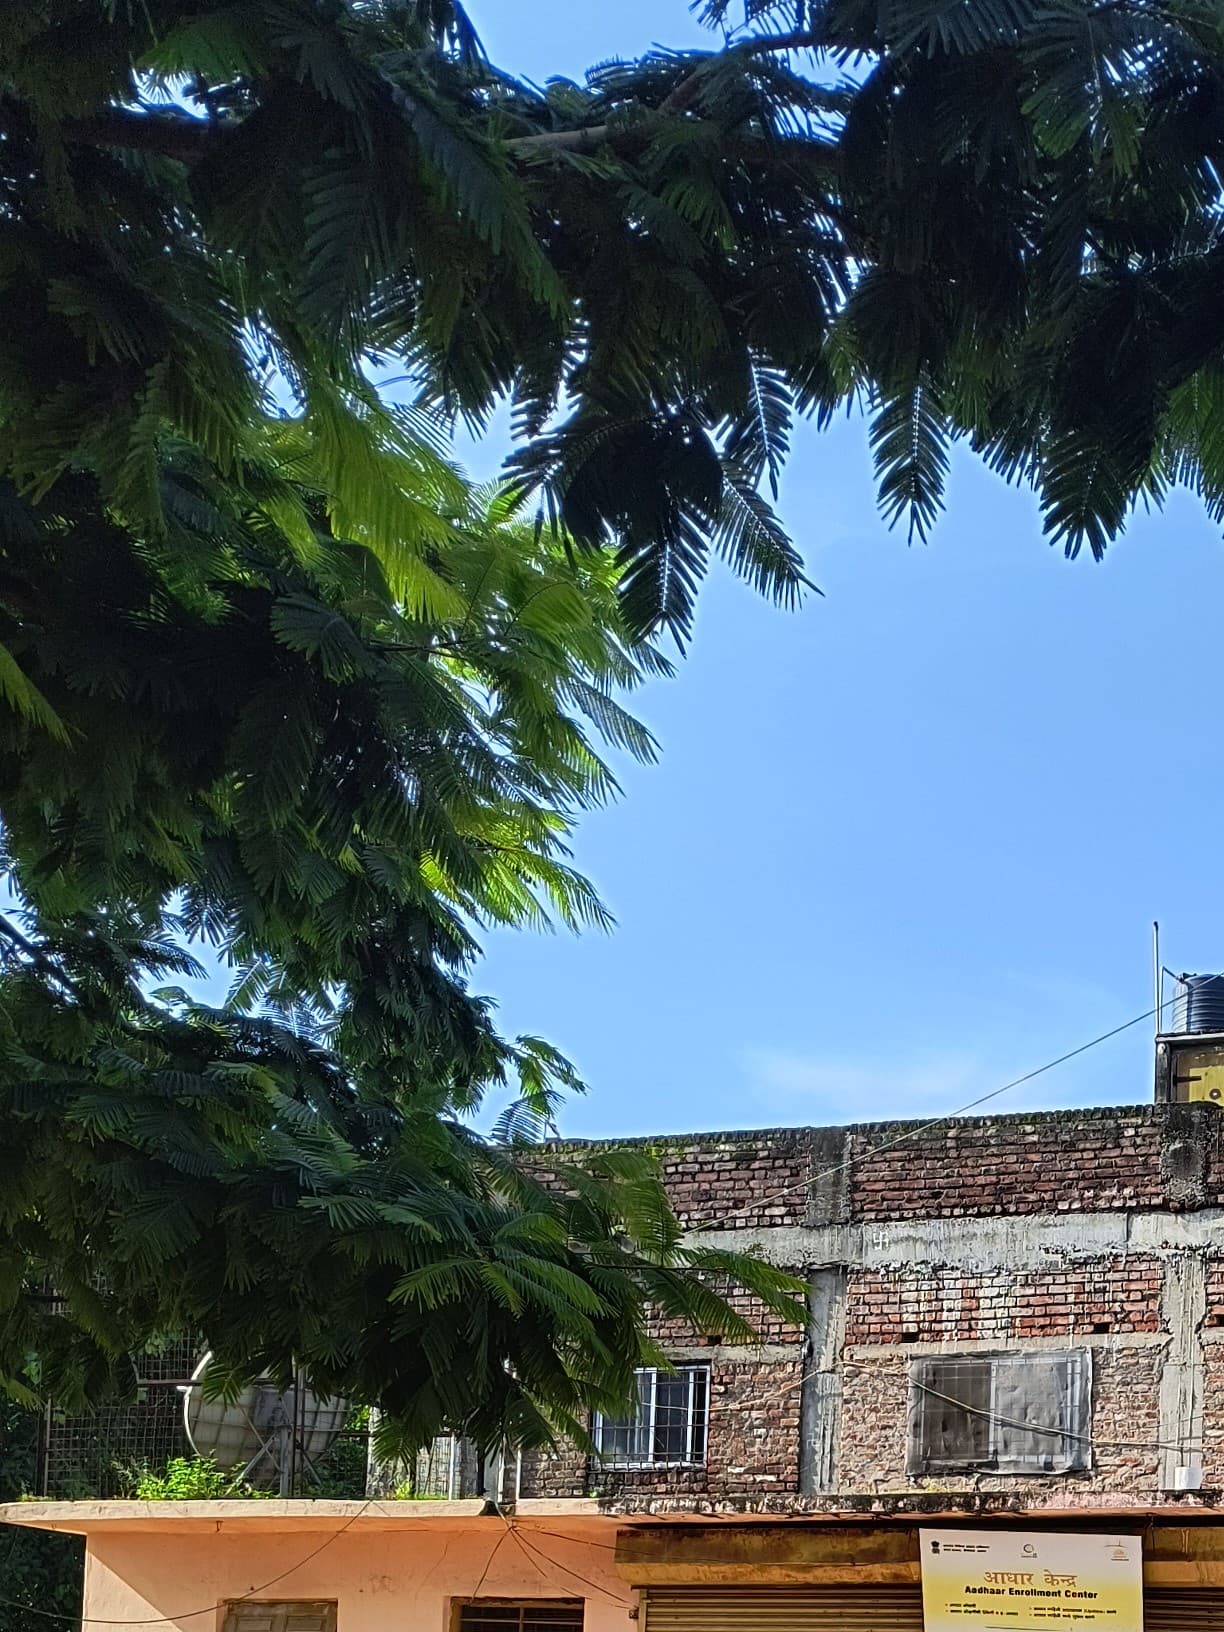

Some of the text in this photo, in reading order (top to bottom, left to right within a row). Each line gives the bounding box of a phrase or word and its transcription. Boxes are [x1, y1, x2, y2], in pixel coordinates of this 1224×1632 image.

[983, 1569, 1078, 1588] आधार केन्द्र
[964, 1585, 1099, 1599] Aadhaar Enrollment Center
